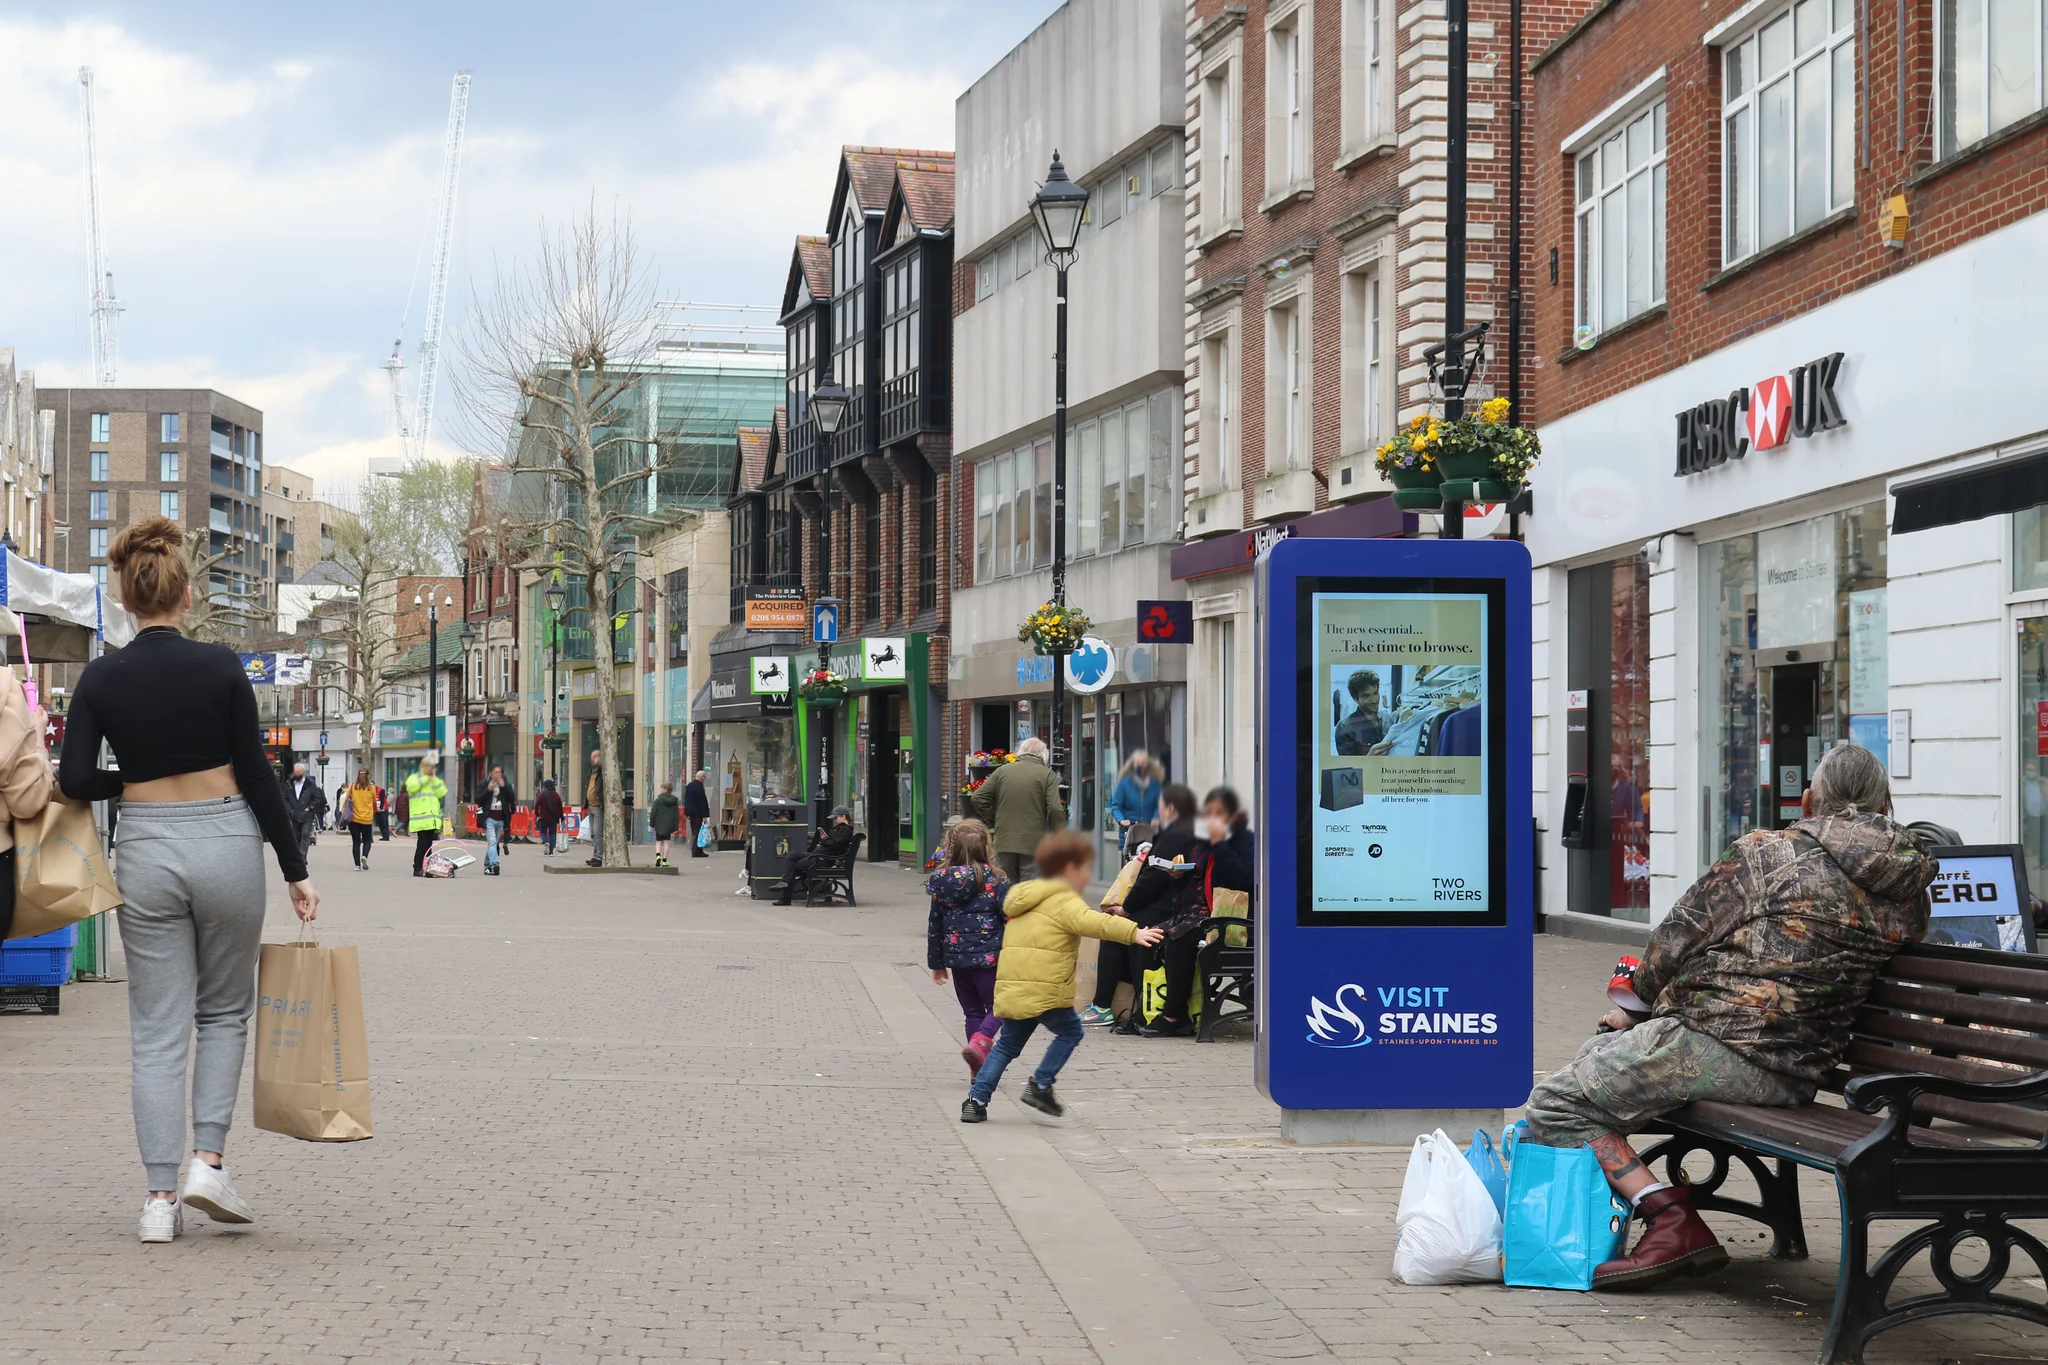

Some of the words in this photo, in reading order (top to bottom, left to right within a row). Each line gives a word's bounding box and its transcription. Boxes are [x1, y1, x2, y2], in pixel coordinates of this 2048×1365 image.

[1674, 388, 1749, 477] HSBC
[1789, 352, 1847, 438] UK
[1767, 568, 1797, 585] Welcome
[751, 602, 804, 611] ACQUIRED
[751, 614, 769, 622] 0208
[771, 614, 784, 622] 954
[787, 614, 804, 622] 0878
[1324, 624, 1344, 634] The
[1347, 626, 1367, 634] new
[1376, 640, 1406, 653] time
[1408, 642, 1421, 653] to
[1424, 640, 1473, 653] browse.
[711, 677, 736, 699] Waterstone's
[1397, 777, 1424, 785] yourself
[1381, 786, 1416, 795] completely
[1325, 824, 1351, 833] next
[1370, 846, 1381, 854] JD
[1935, 869, 1970, 881] AFFÈ
[1432, 878, 1465, 888] TWO
[1434, 890, 1482, 901] RIVERS
[1929, 883, 1998, 904] ERO
[1377, 987, 1449, 1008] VISIT
[1379, 1013, 1498, 1034] STAINES
[332, 1003, 345, 1092] primark.com
